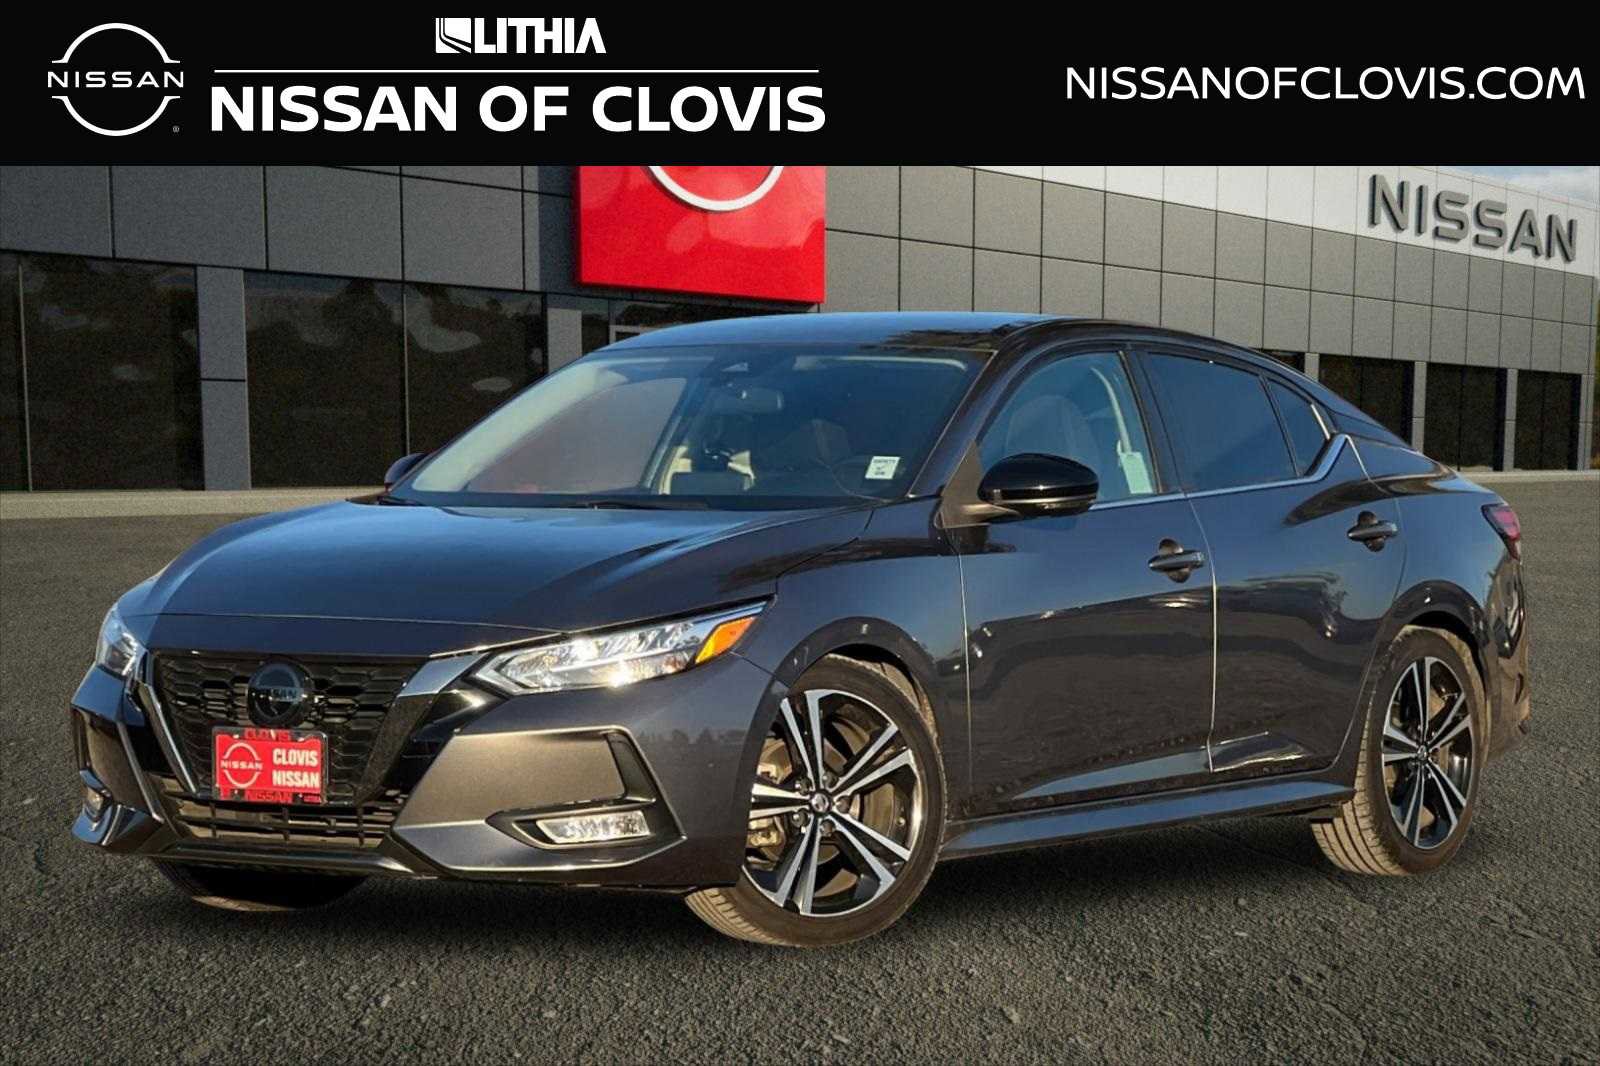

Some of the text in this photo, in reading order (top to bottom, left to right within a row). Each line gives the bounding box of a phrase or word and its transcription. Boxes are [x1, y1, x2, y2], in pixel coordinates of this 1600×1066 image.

[1368, 173, 1577, 263] NISSAN
[220, 760, 264, 770] NISSAN
[272, 748, 319, 767] CLOVIS
[272, 770, 320, 788] NISSAN
